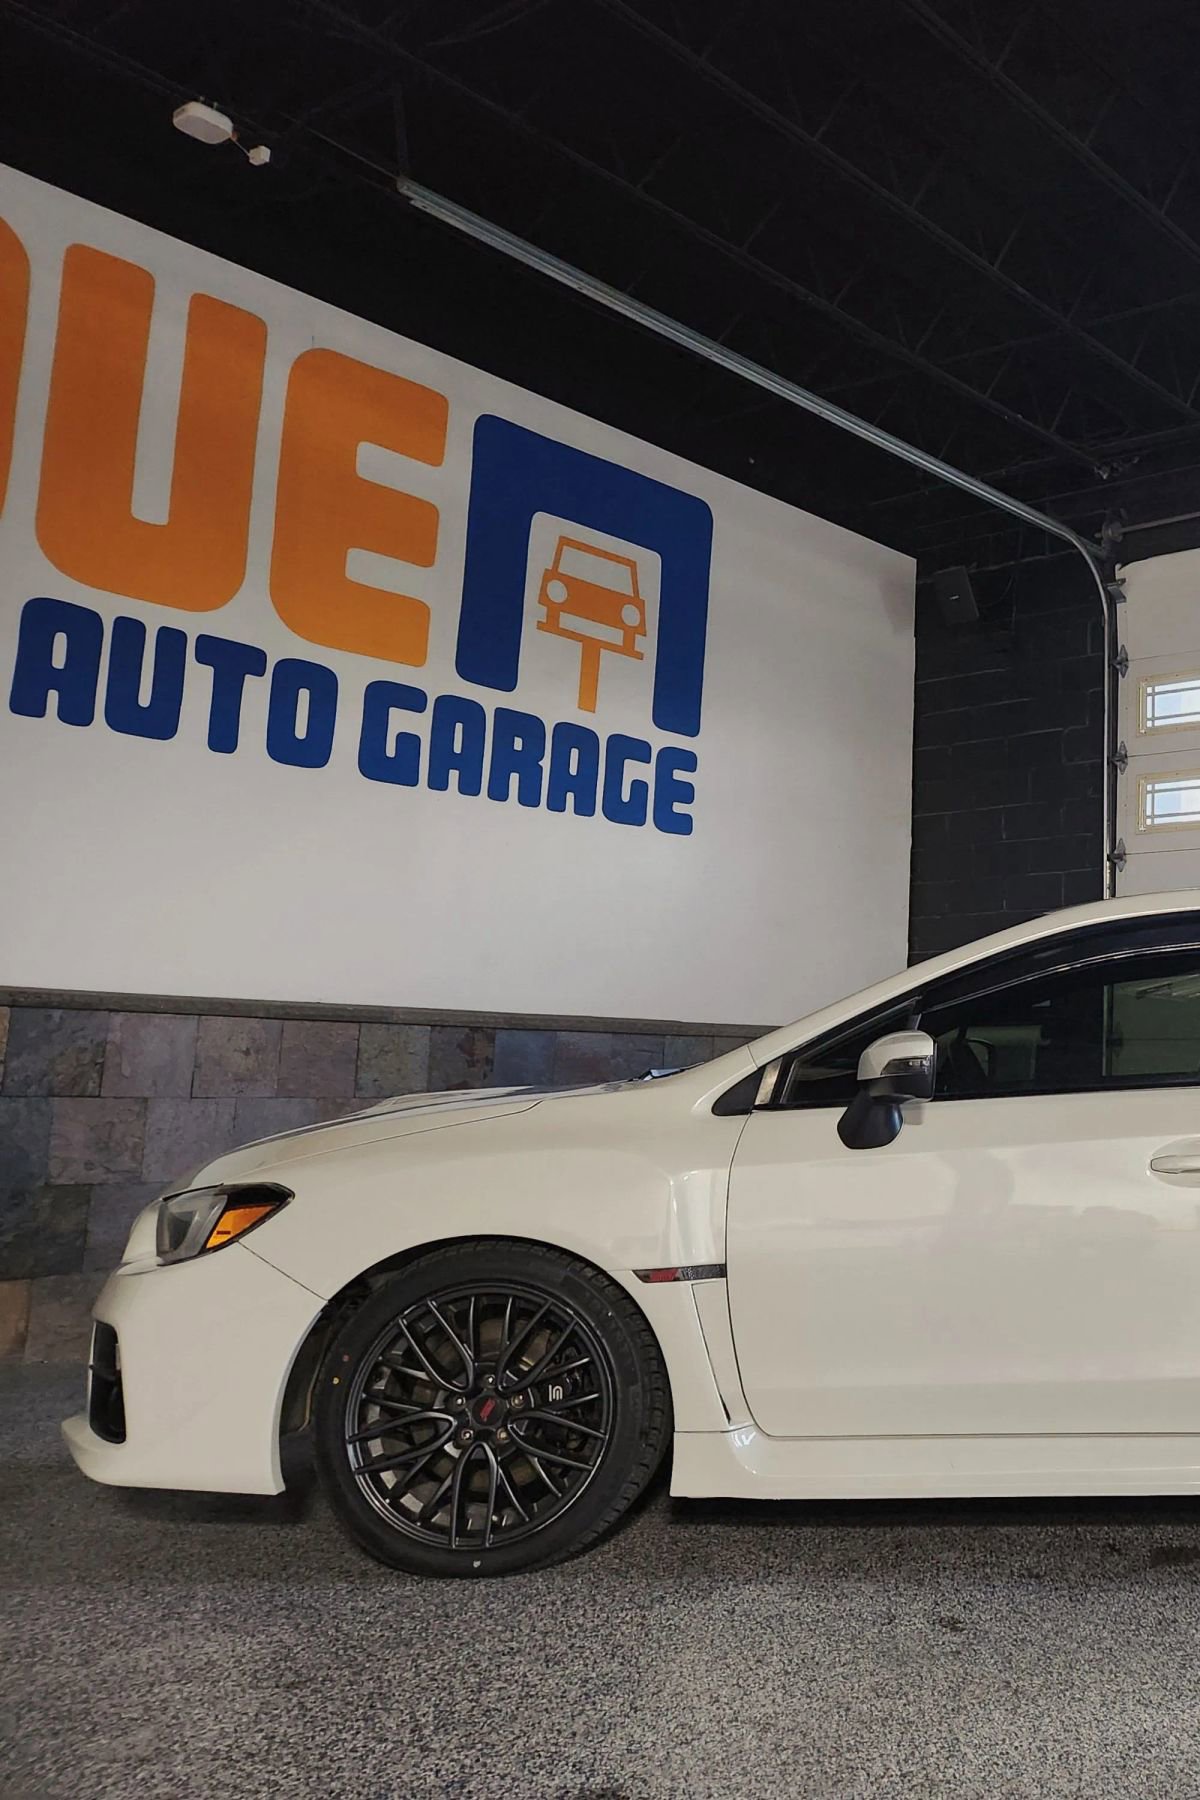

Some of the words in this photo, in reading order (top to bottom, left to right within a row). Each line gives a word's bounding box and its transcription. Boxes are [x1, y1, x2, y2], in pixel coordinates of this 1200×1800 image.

[0, 215, 449, 668] UE
[9, 597, 339, 769] AUTO
[358, 679, 698, 836] GARAGE
